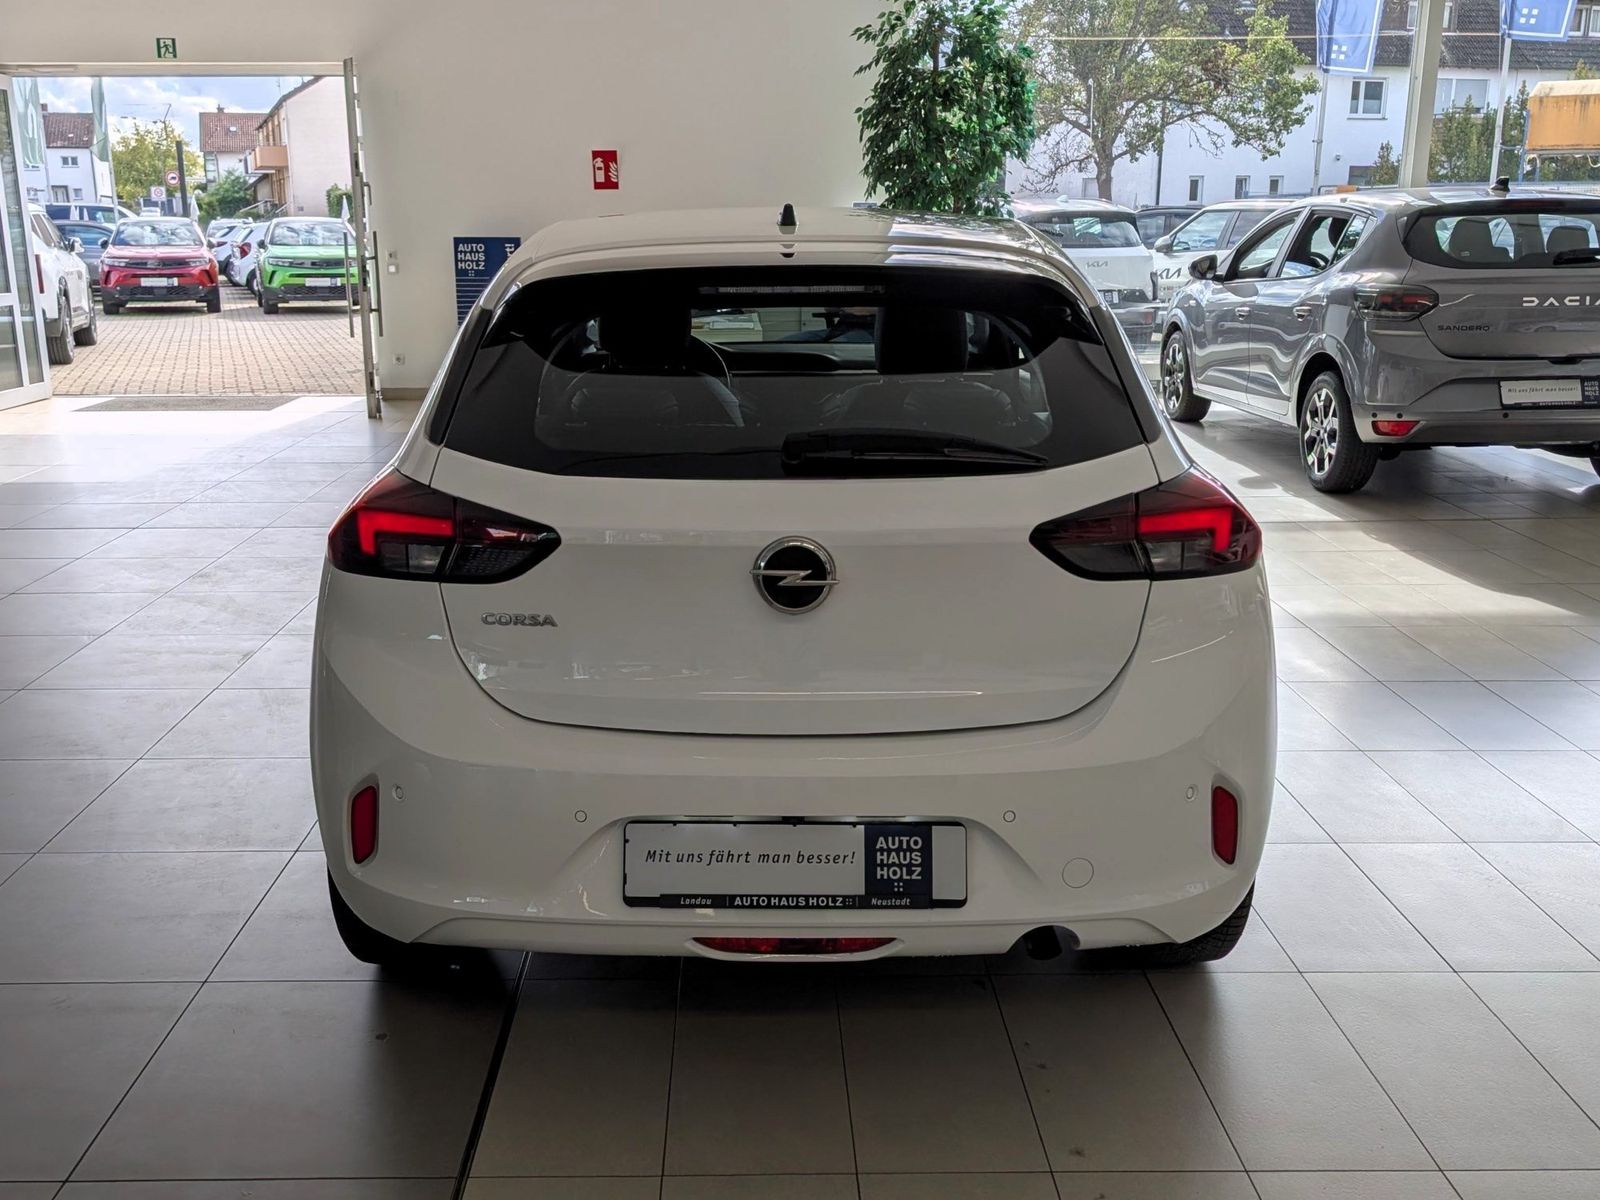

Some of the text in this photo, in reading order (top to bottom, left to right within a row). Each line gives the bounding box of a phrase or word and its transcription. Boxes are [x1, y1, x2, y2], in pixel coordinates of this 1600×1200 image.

[457, 243, 485, 252] AUTO
[457, 252, 486, 261] HAUS
[457, 261, 486, 270] HOLZ
[1086, 260, 1109, 268] KIA
[1437, 324, 1490, 332] SANDERO
[480, 612, 558, 628] CORSA
[875, 836, 922, 849] AUTO
[645, 850, 856, 867] Mit uns fährt man besser!
[876, 851, 922, 864] HAUS
[876, 866, 922, 880] HOLZ
[680, 896, 911, 907] Landau AUTO HAUS HOLZ Neustadt
